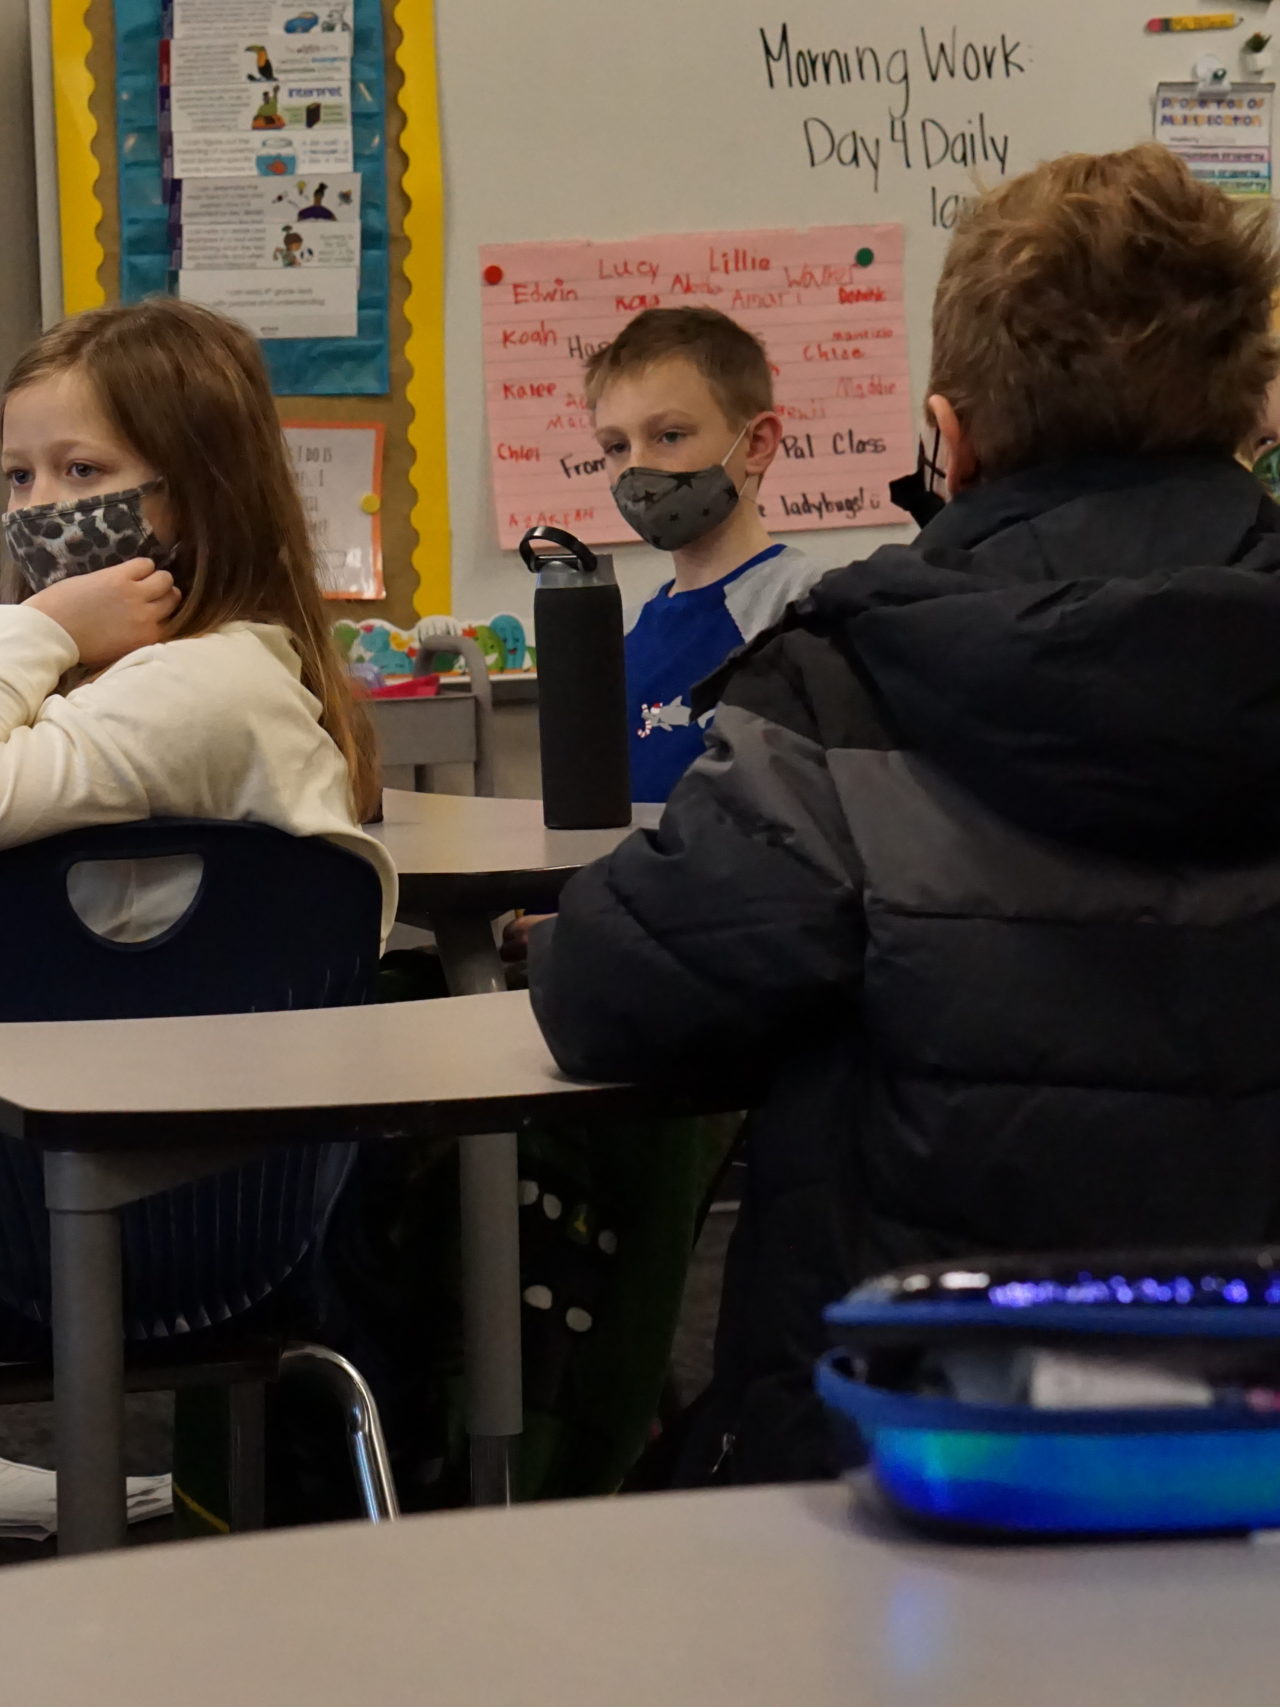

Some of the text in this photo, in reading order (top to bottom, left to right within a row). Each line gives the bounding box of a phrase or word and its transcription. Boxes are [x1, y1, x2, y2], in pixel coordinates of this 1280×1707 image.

[760, 22, 910, 120] Morning
[803, 112, 1009, 193] Day 4 Daily
[931, 186, 970, 230] la
[598, 258, 660, 285] Lucy
[709, 247, 772, 275] Lillie
[511, 278, 579, 305] Edwin
[780, 433, 815, 459] Pal
[832, 428, 887, 456] Class
